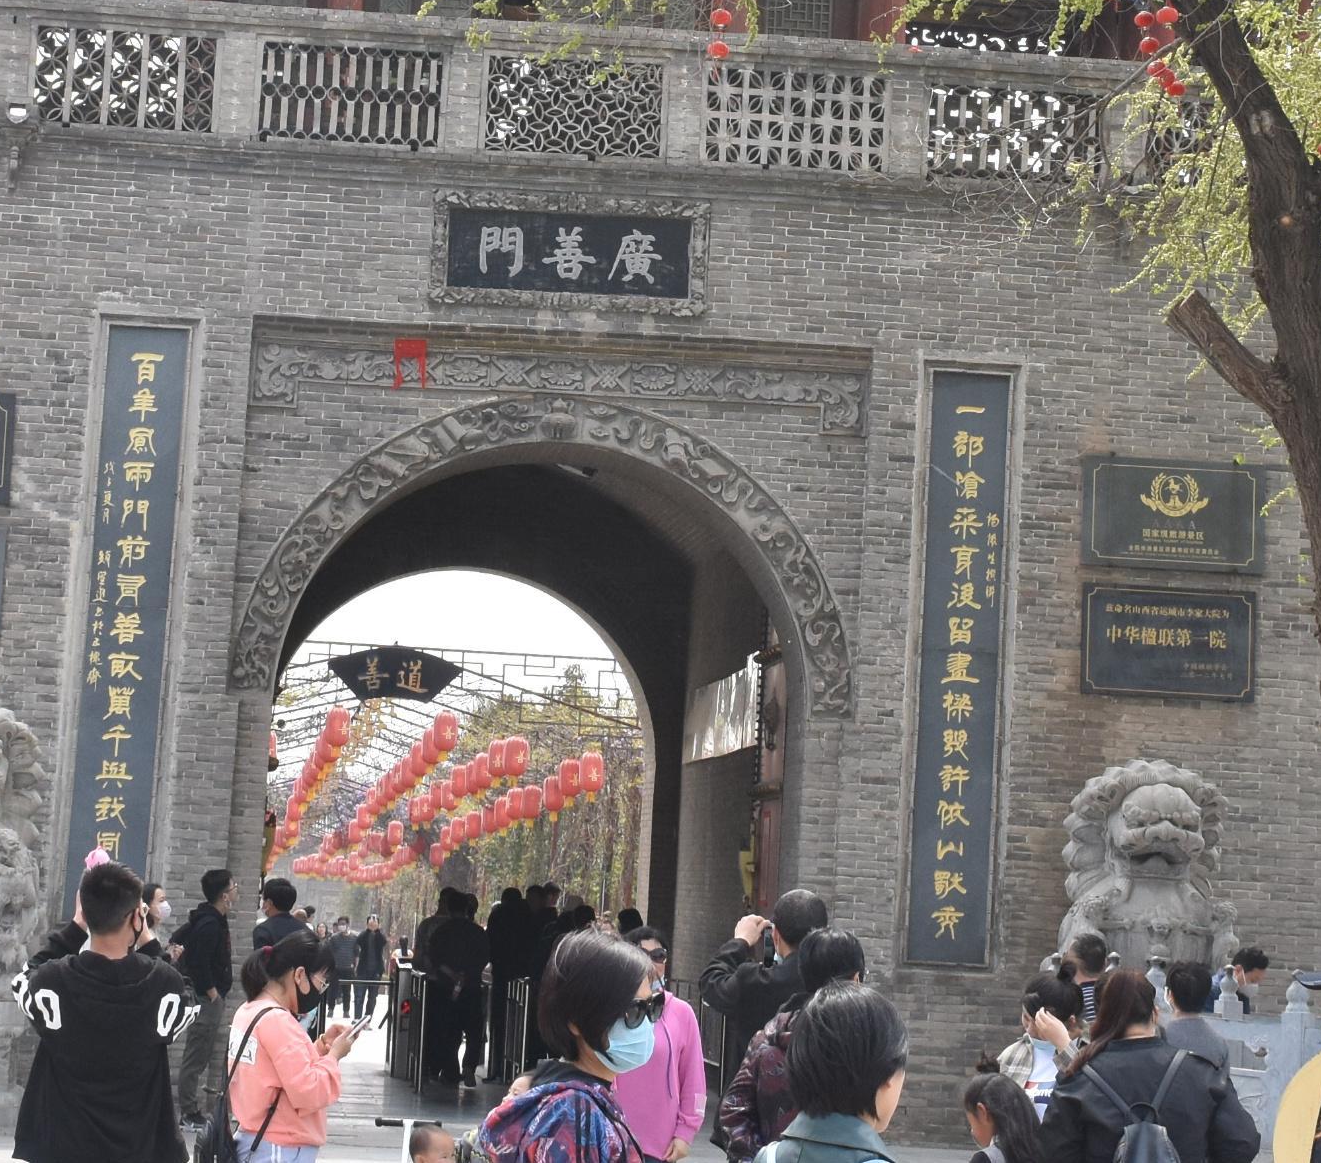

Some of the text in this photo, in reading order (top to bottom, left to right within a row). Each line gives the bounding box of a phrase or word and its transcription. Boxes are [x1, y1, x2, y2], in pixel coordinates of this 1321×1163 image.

[1106, 624, 1227, 649] 中华楹联第一院
